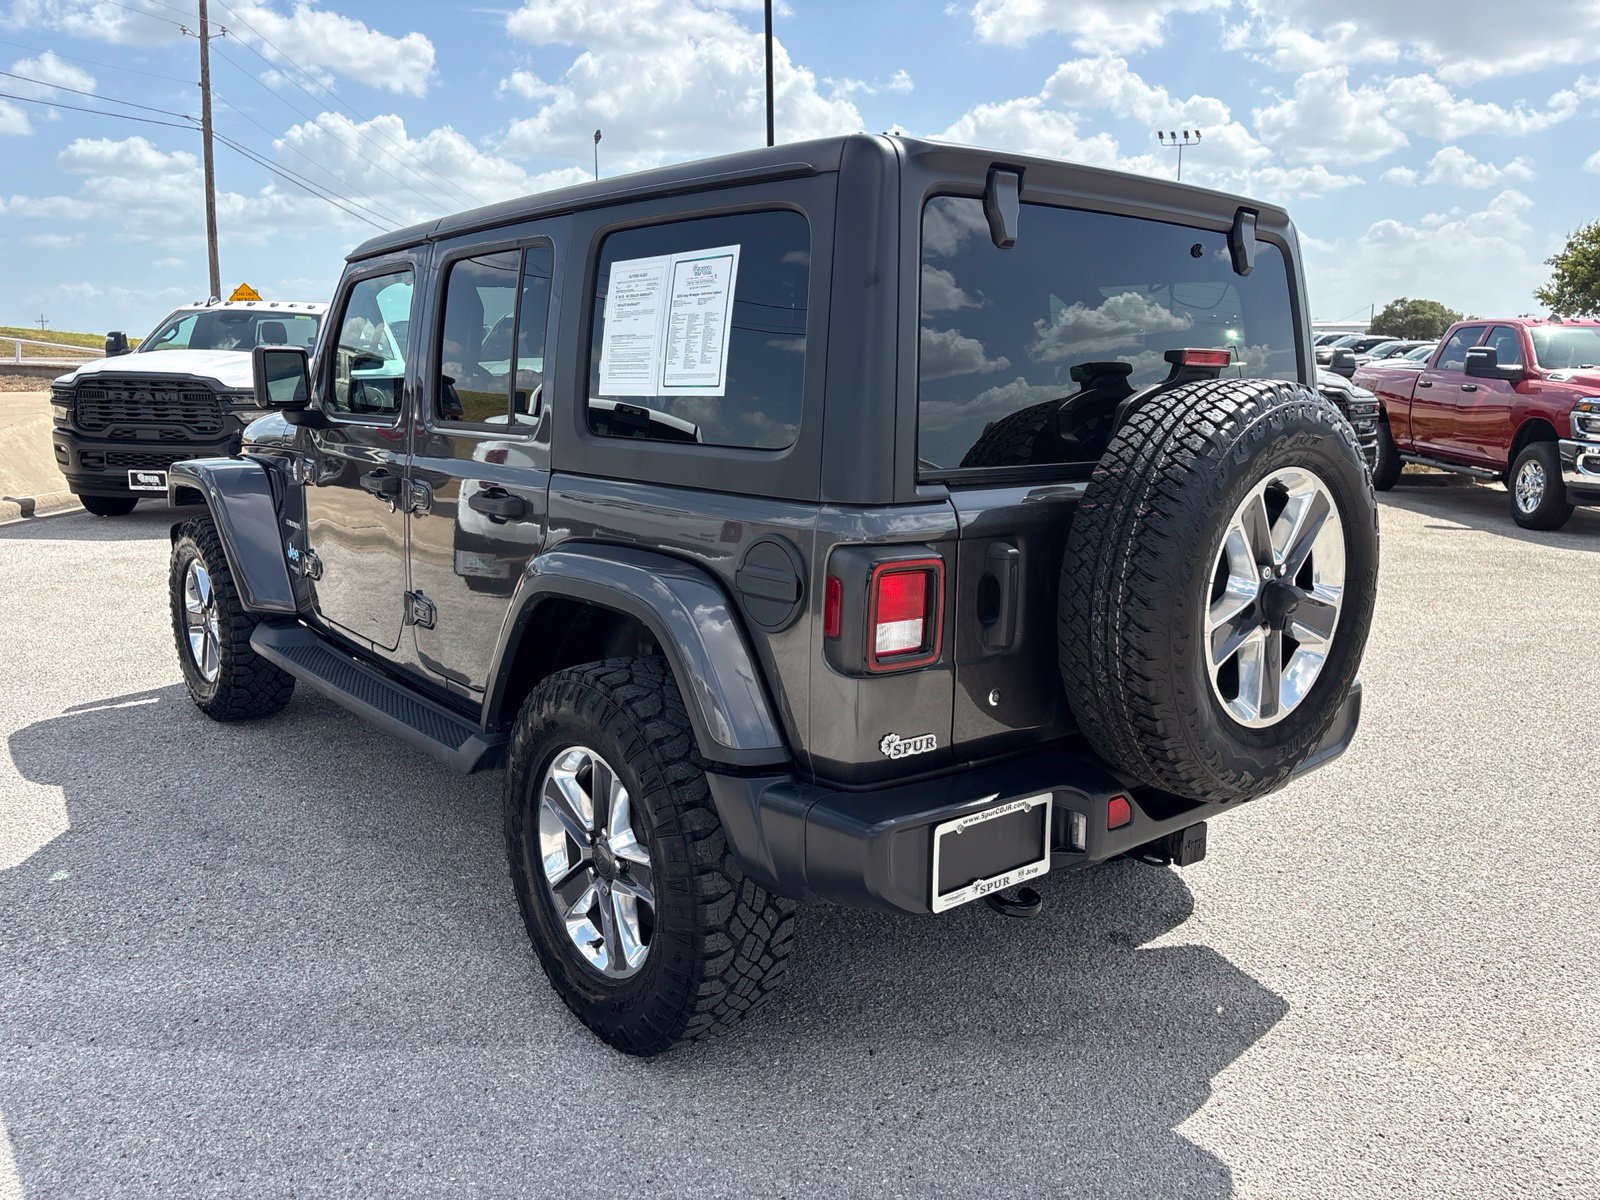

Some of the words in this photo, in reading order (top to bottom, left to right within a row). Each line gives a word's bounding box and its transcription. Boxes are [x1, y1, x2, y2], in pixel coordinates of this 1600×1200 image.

[108, 390, 178, 401] RAM
[287, 542, 299, 562] Jee
[893, 737, 934, 756] SPUR
[962, 801, 1027, 824] www.SpurCDJR.com
[1184, 838, 1205, 851] Jeep
[1025, 867, 1039, 876] Jeep
[980, 876, 1010, 894] SPUR
